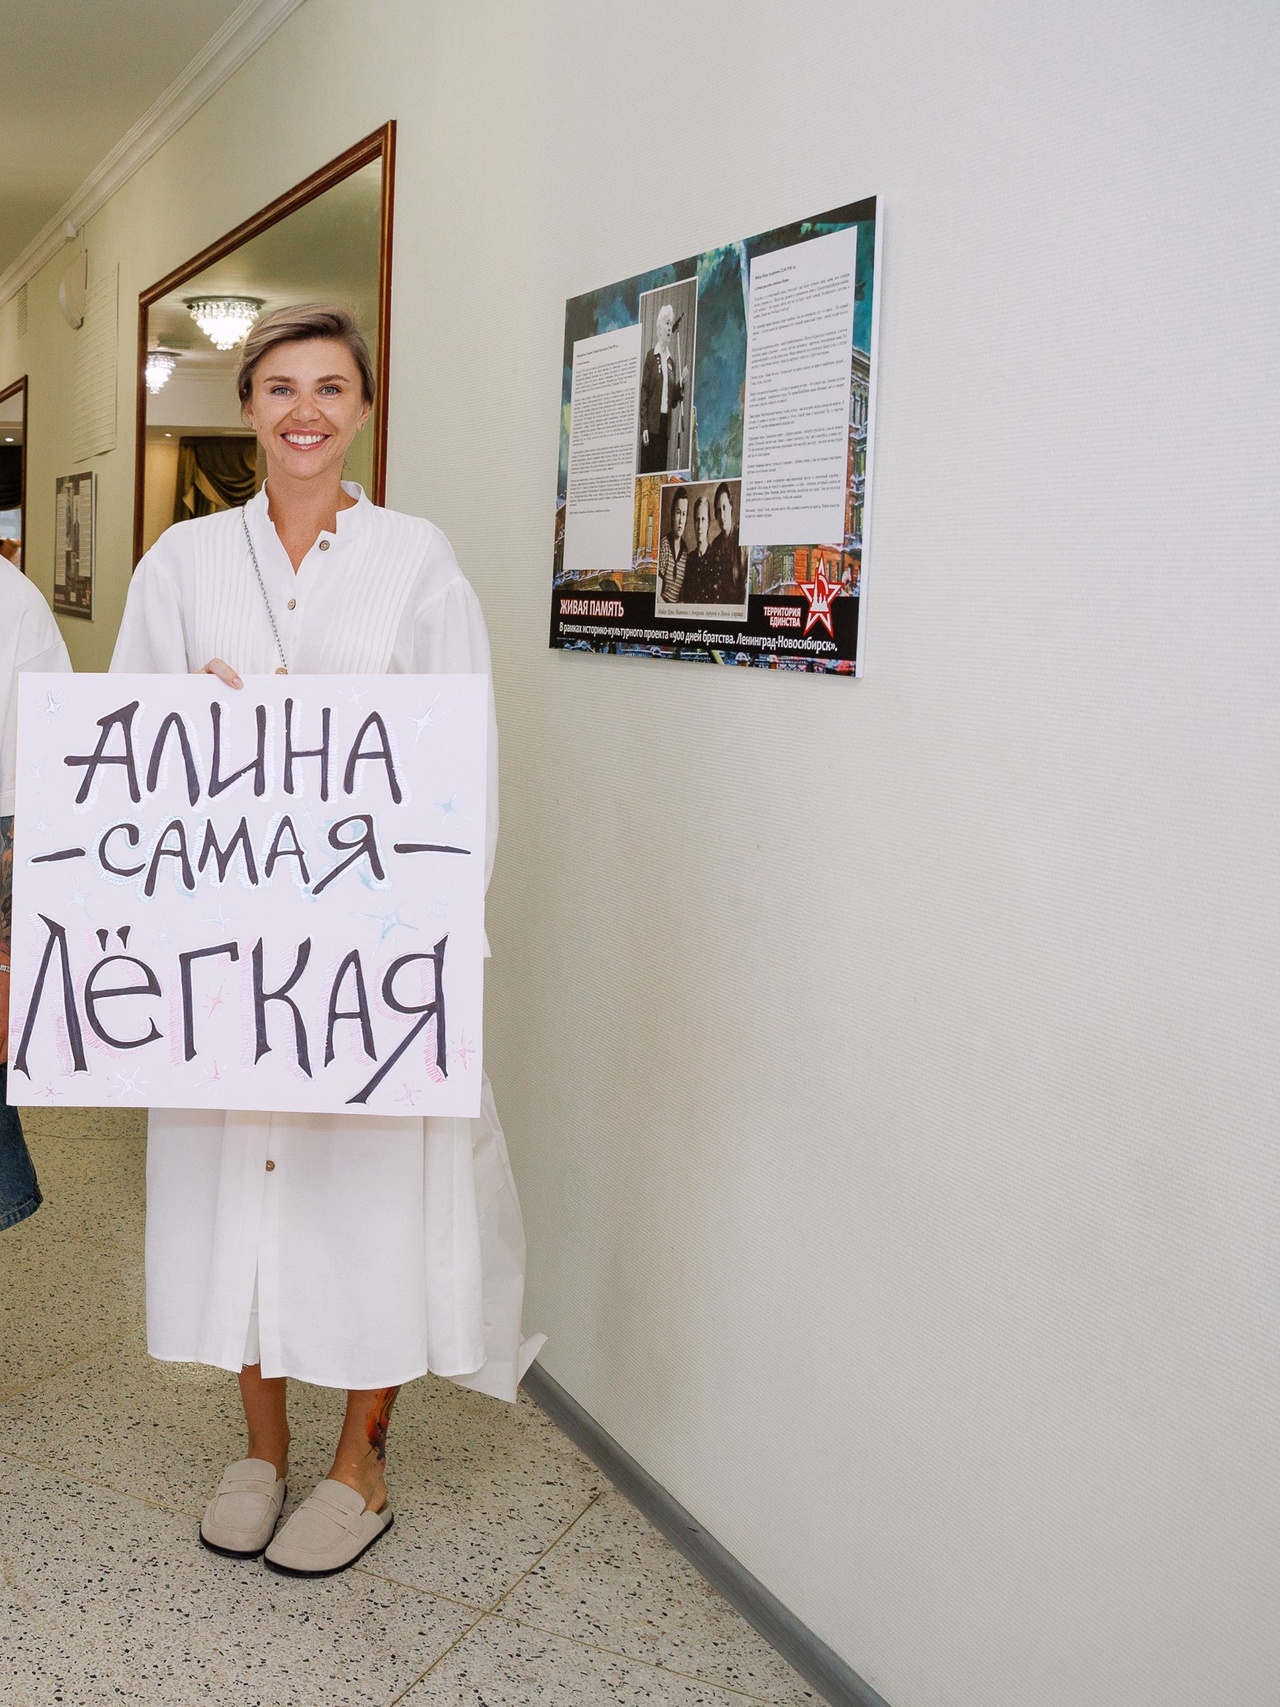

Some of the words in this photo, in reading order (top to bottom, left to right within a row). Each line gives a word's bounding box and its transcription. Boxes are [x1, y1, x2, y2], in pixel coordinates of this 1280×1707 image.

[560, 599, 588, 616] ЖИВАЯ
[589, 600, 625, 618] ПАМЯТЬ
[763, 606, 801, 617] ТЕРРИТОРИЯ
[769, 616, 801, 628] ЕДИНСТВА
[559, 621, 564, 632] В
[564, 624, 582, 637] рамках
[582, 624, 643, 639] историко-культурного
[643, 629, 669, 641] проекта
[669, 631, 685, 643] «900
[685, 629, 702, 644] дней
[702, 630, 735, 646] братства.
[63, 698, 404, 807] АЛИНА
